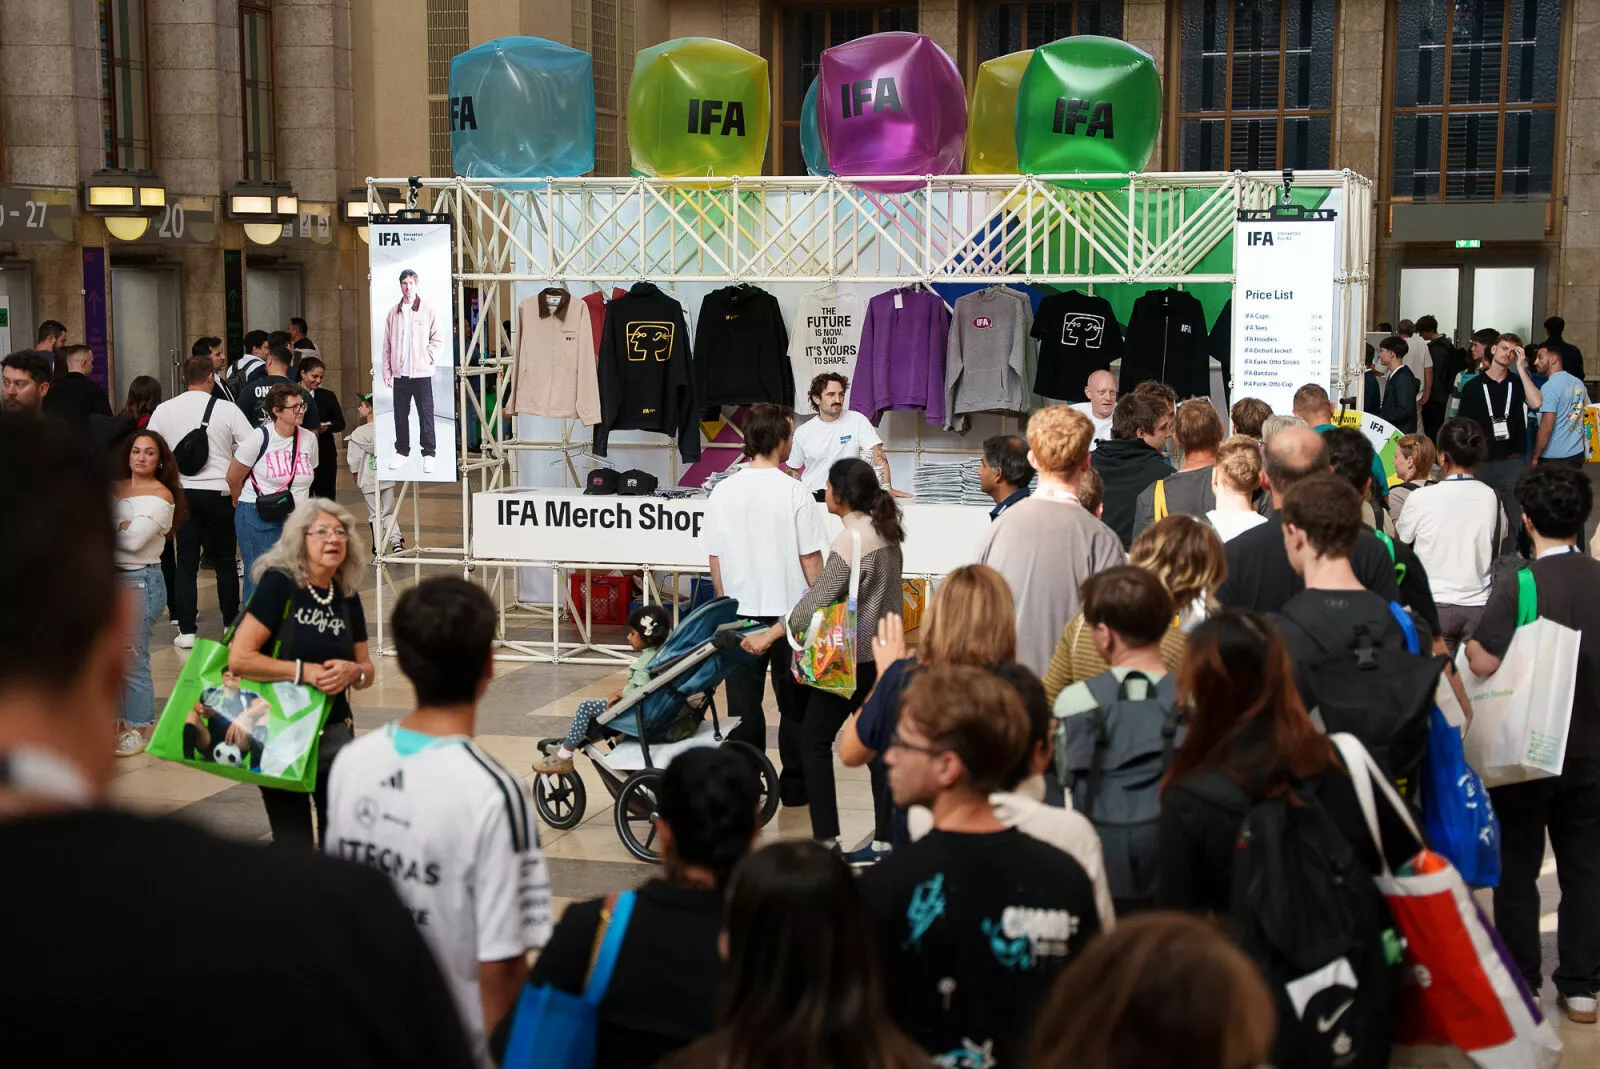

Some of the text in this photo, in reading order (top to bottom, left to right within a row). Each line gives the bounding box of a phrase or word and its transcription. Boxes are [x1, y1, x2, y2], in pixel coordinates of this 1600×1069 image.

[841, 77, 903, 118] IFA
[687, 99, 746, 137] IFA
[1052, 97, 1114, 139] IFA
[25, 200, 47, 228] 27
[158, 203, 184, 239] 20
[378, 232, 401, 246] IFA
[1248, 232, 1274, 246] IFA
[1245, 290, 1294, 300] Price List
[807, 316, 852, 328] FUTURE
[976, 318, 989, 326] IFA
[1181, 324, 1192, 334] IFA
[806, 345, 856, 356] IT'S YOURS
[1370, 421, 1384, 434] IFA
[497, 500, 705, 538] IFA Merch Shop
